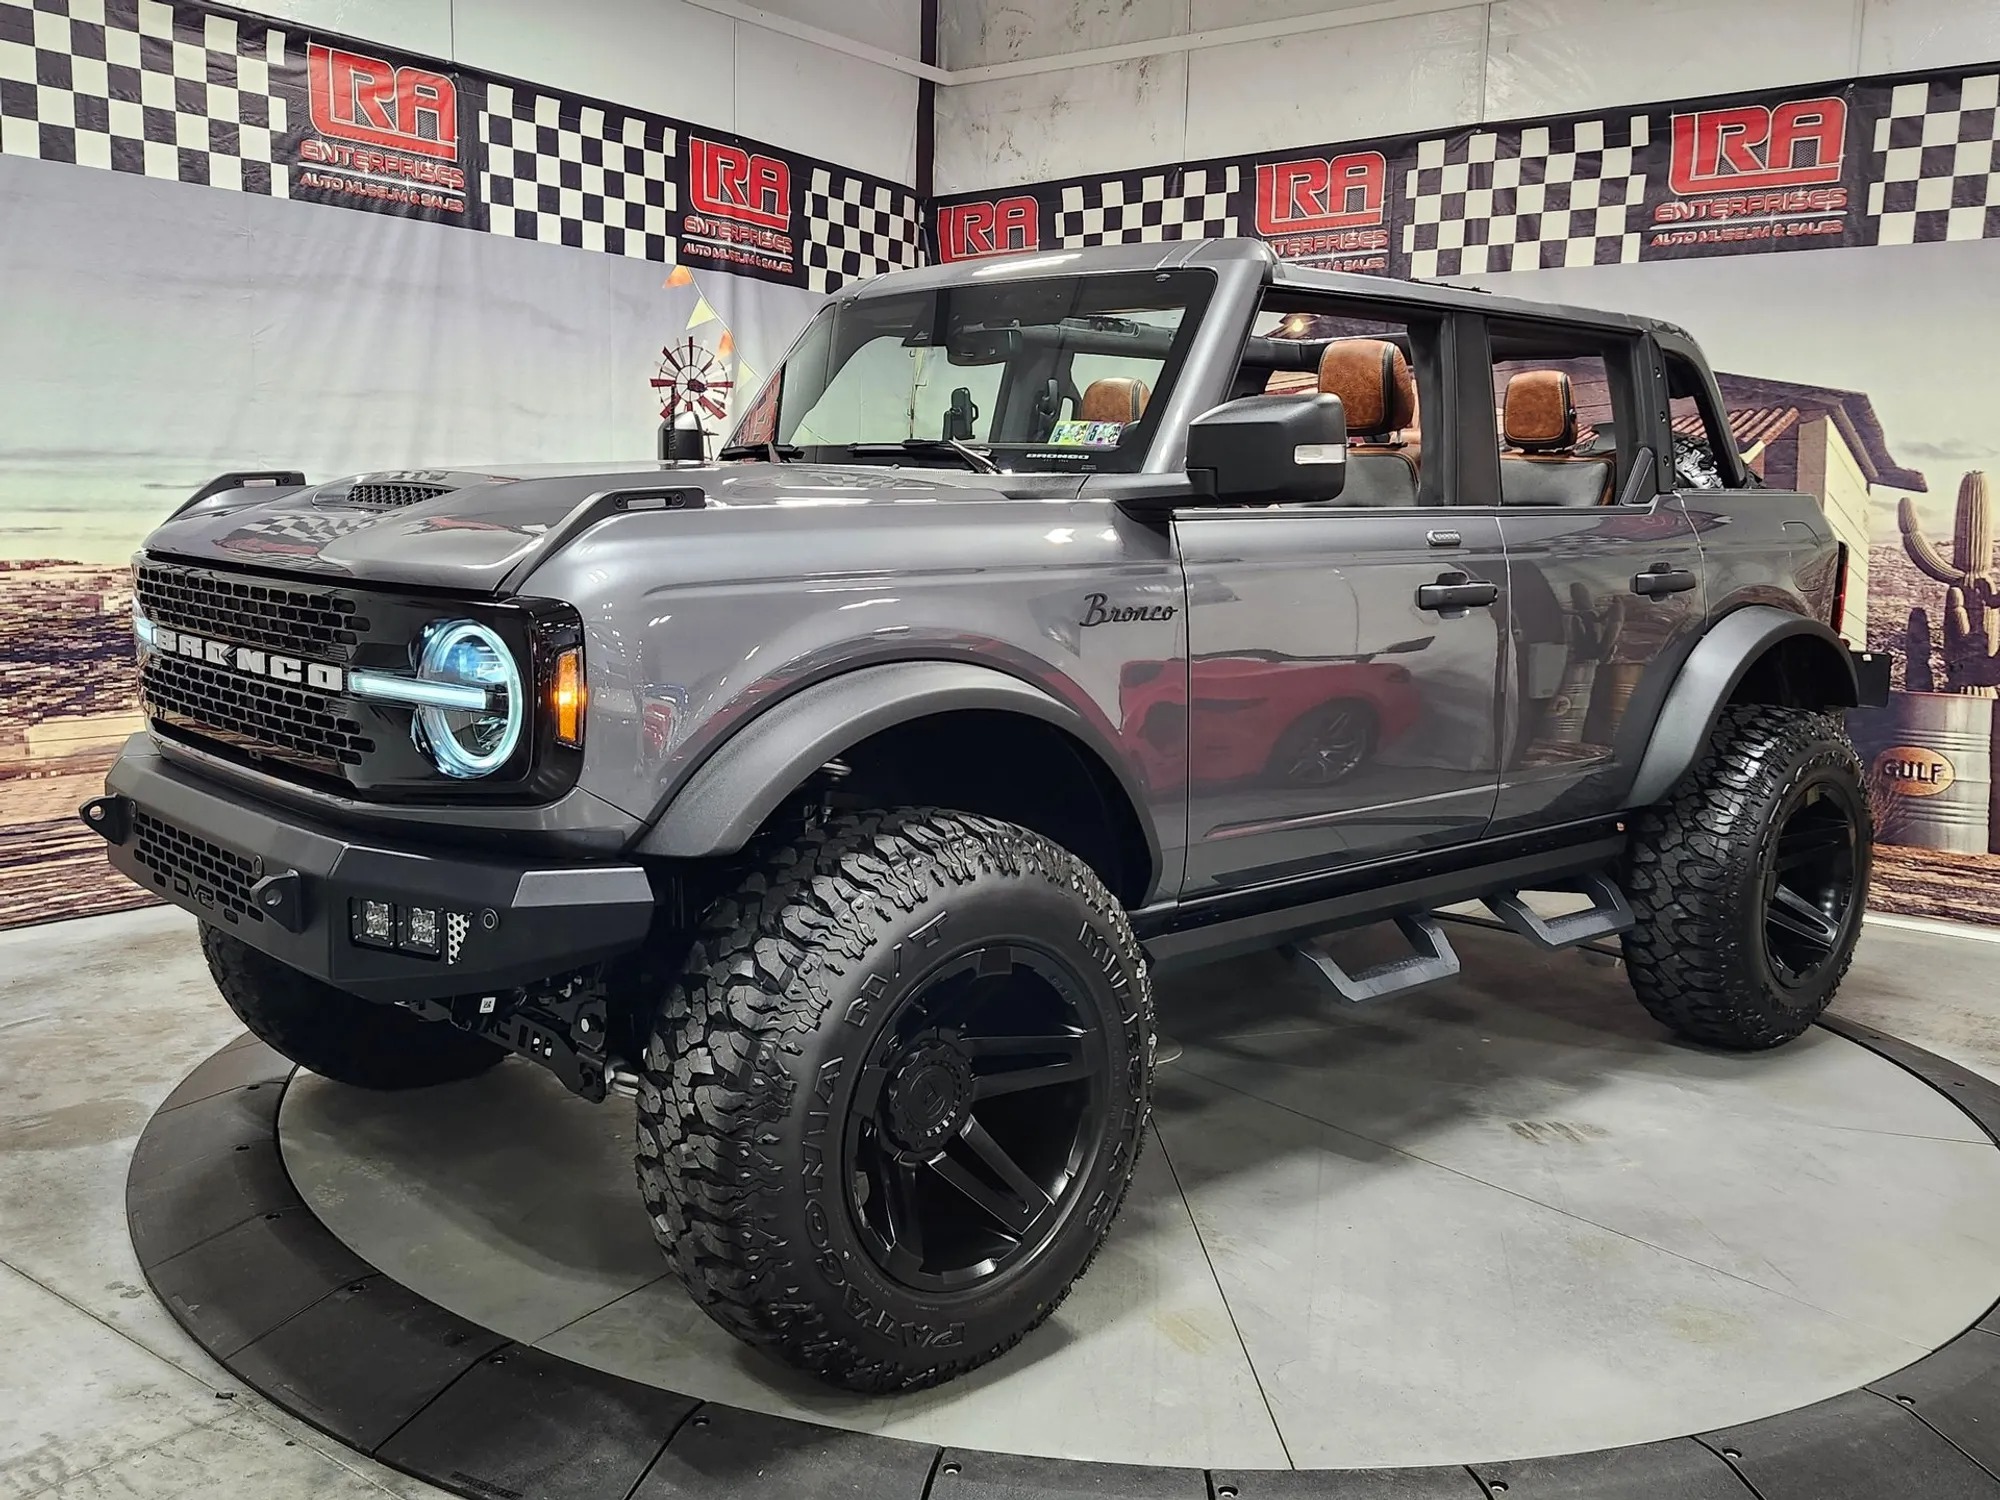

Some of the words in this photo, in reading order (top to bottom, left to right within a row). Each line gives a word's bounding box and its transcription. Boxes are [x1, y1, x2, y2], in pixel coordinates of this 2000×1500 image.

[307, 42, 458, 162] LRA
[300, 139, 465, 188] ENTERPRISES
[1668, 96, 1848, 195] LRA
[300, 172, 344, 190] AUTO
[345, 180, 408, 202] MUSEUM
[421, 193, 464, 213] SALES
[689, 136, 790, 232] LRA
[1255, 150, 1386, 236] LRA
[1654, 187, 1848, 222] ENTERPRISES
[683, 242, 712, 257] AUTO
[684, 215, 793, 254] ENTERPRISES
[1271, 229, 1388, 256] TERPRISES
[1650, 230, 1698, 246] AUTO
[1699, 225, 1772, 244] MUSEUM
[1786, 220, 1844, 236] SALES
[1078, 592, 1179, 627] Bronco
[1882, 757, 1945, 785] GULF
[801, 1056, 966, 1348] PATAGONIA
